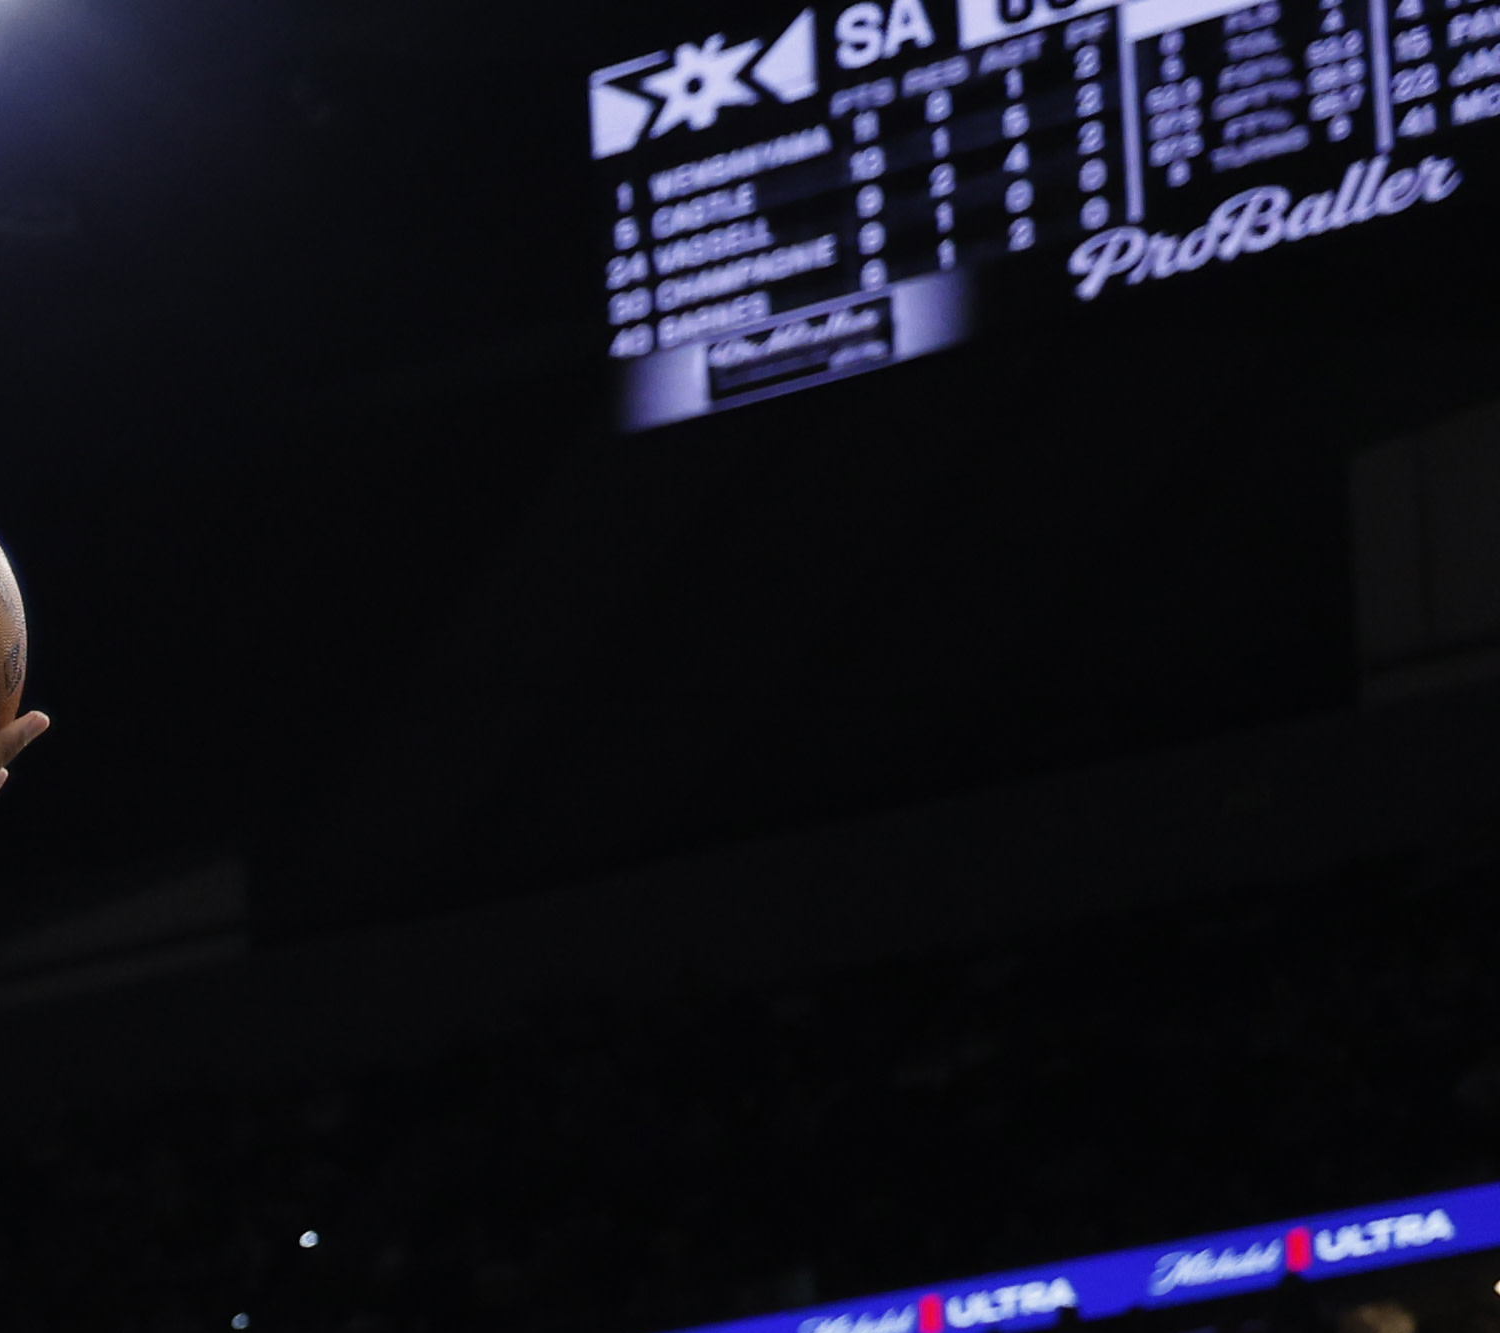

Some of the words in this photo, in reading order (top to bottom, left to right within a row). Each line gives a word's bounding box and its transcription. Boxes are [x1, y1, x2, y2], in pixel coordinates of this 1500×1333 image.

[835, 0, 936, 69] SA
[1067, 154, 1463, 301] ProBaller
[1315, 1208, 1455, 1262] ULTRA
[947, 1277, 1077, 1328] ULTRA
